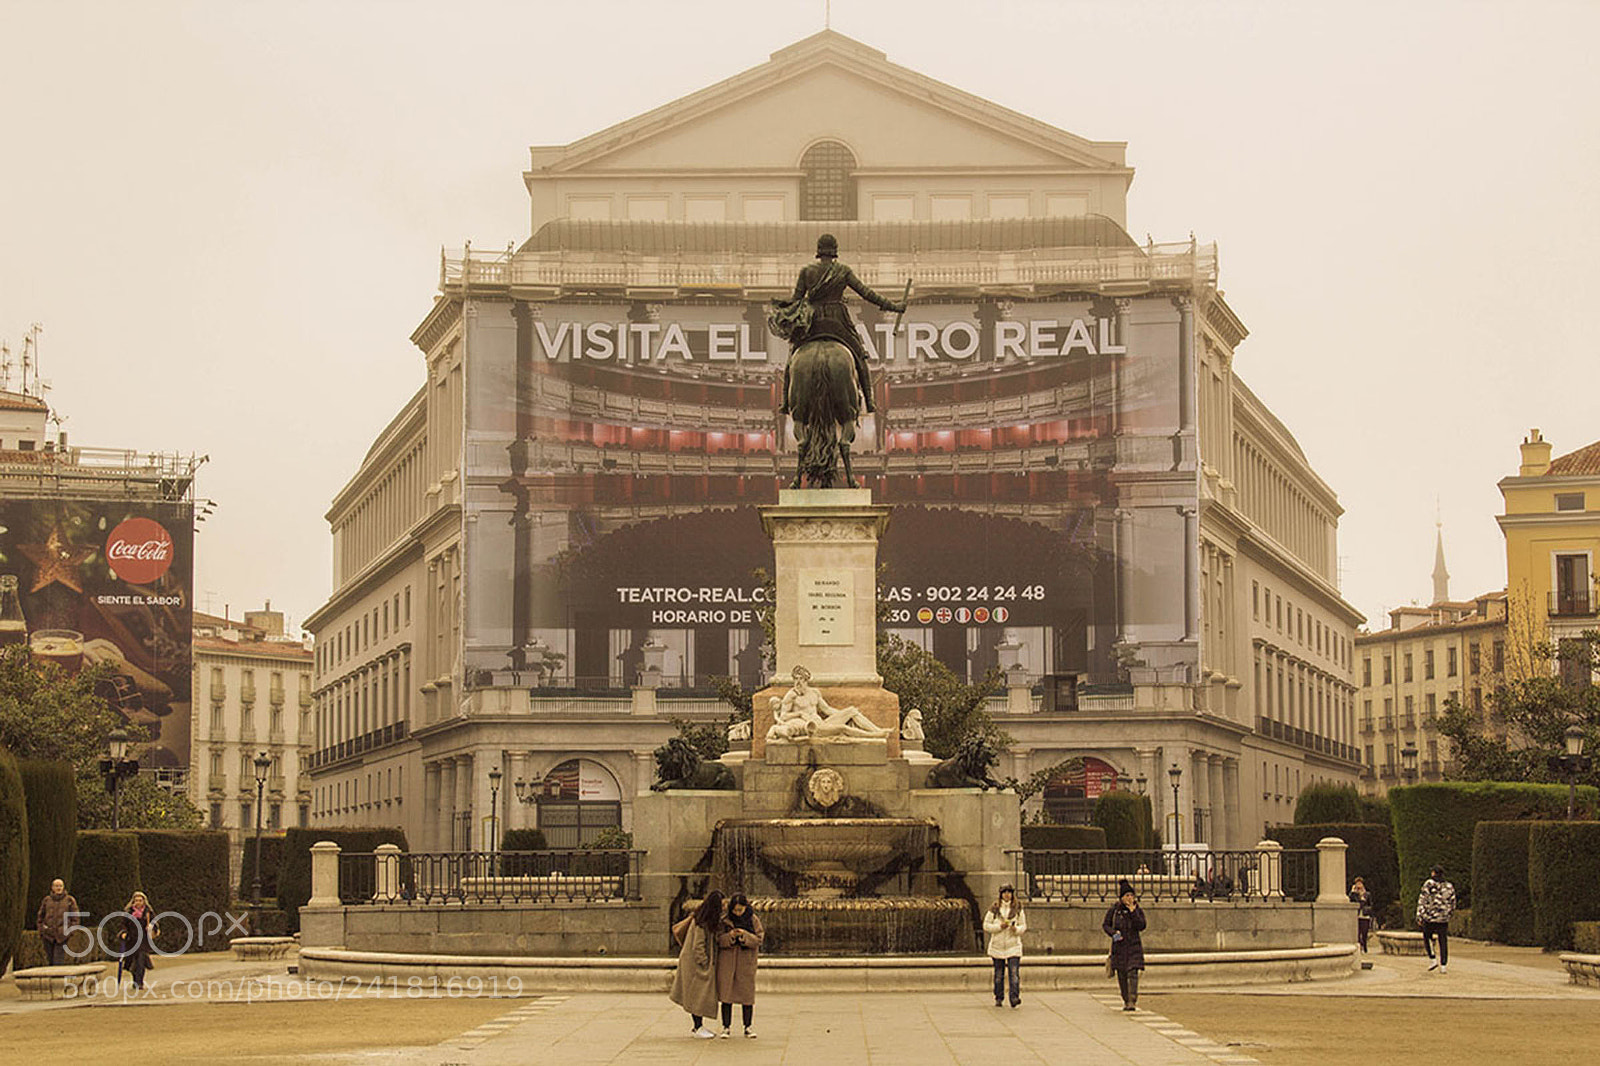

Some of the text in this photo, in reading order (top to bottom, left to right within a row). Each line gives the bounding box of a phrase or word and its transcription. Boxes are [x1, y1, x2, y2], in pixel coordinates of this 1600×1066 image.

[534, 317, 1127, 361] VISITA EL ATRO REAL
[108, 539, 171, 561] Coca-Cola
[97, 595, 181, 606] SIENTE EL SABOR
[616, 587, 773, 603] TEATRO-REAL.C
[926, 586, 962, 602] 902
[966, 585, 989, 601] 24
[993, 585, 1017, 601] 24
[1021, 584, 1046, 600] 48
[652, 610, 726, 623] HORARIO
[730, 610, 752, 623] DE
